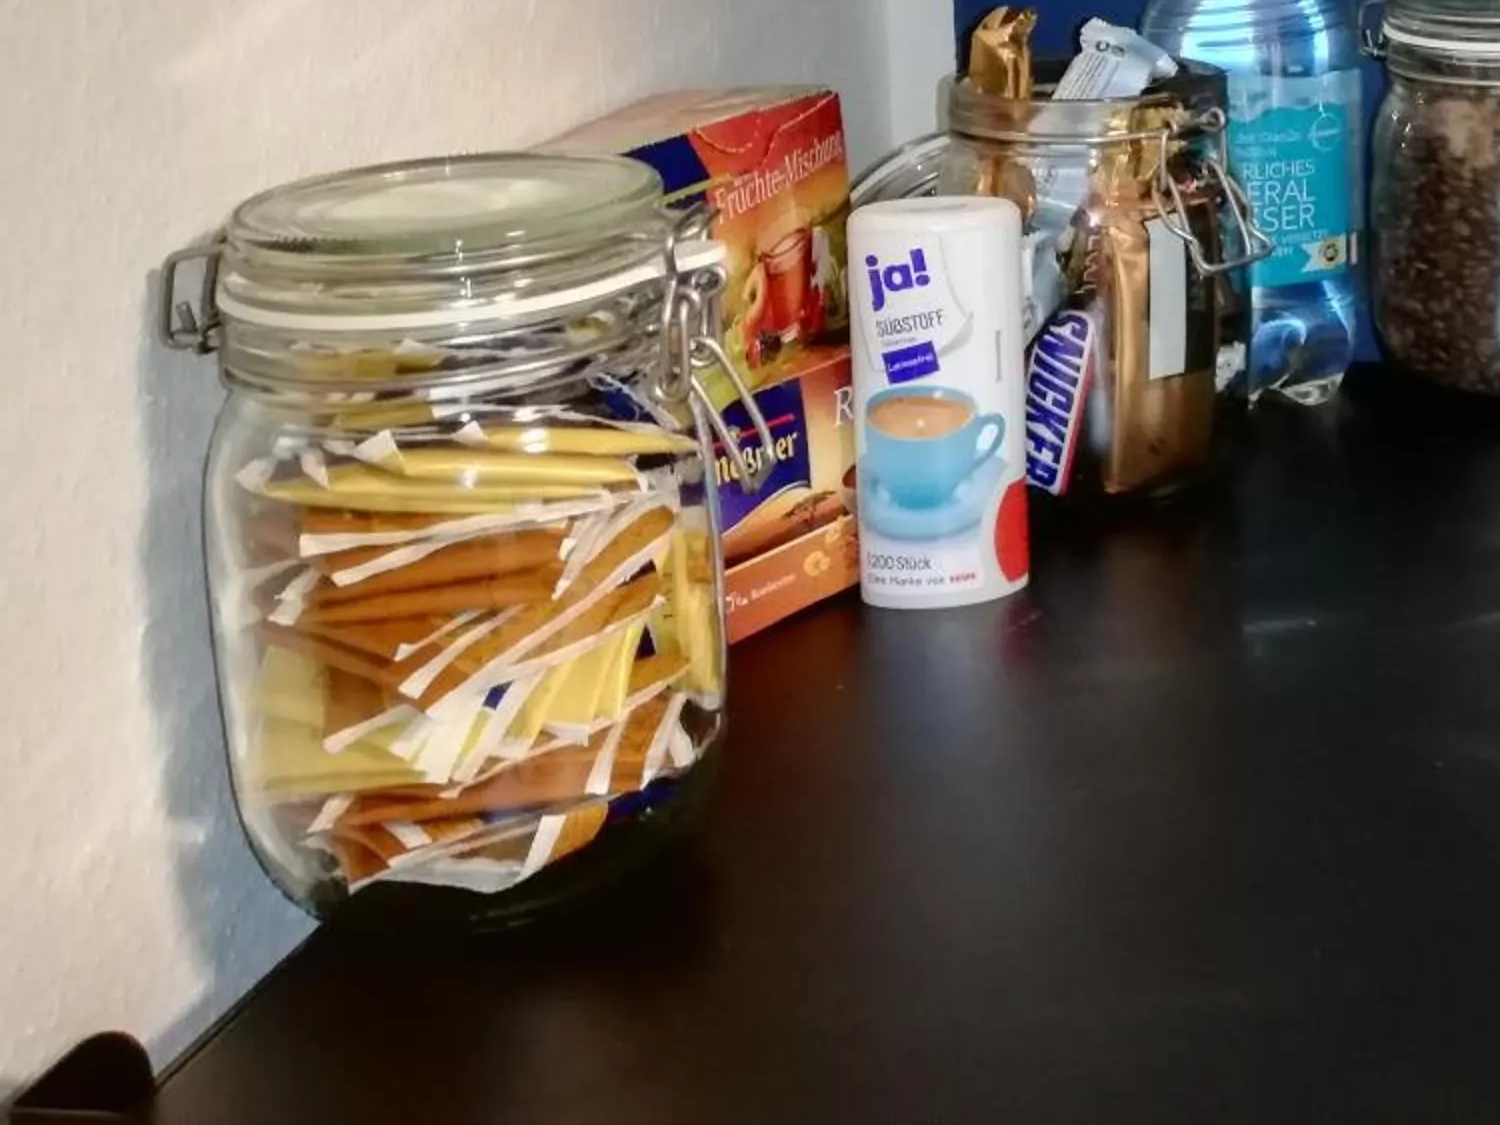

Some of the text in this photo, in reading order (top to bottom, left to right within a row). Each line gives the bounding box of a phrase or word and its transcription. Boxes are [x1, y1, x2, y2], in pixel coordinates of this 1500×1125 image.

[1243, 159, 1316, 180] RLICHES
[1247, 178, 1316, 206] ERAL
[865, 248, 930, 312] ja!
